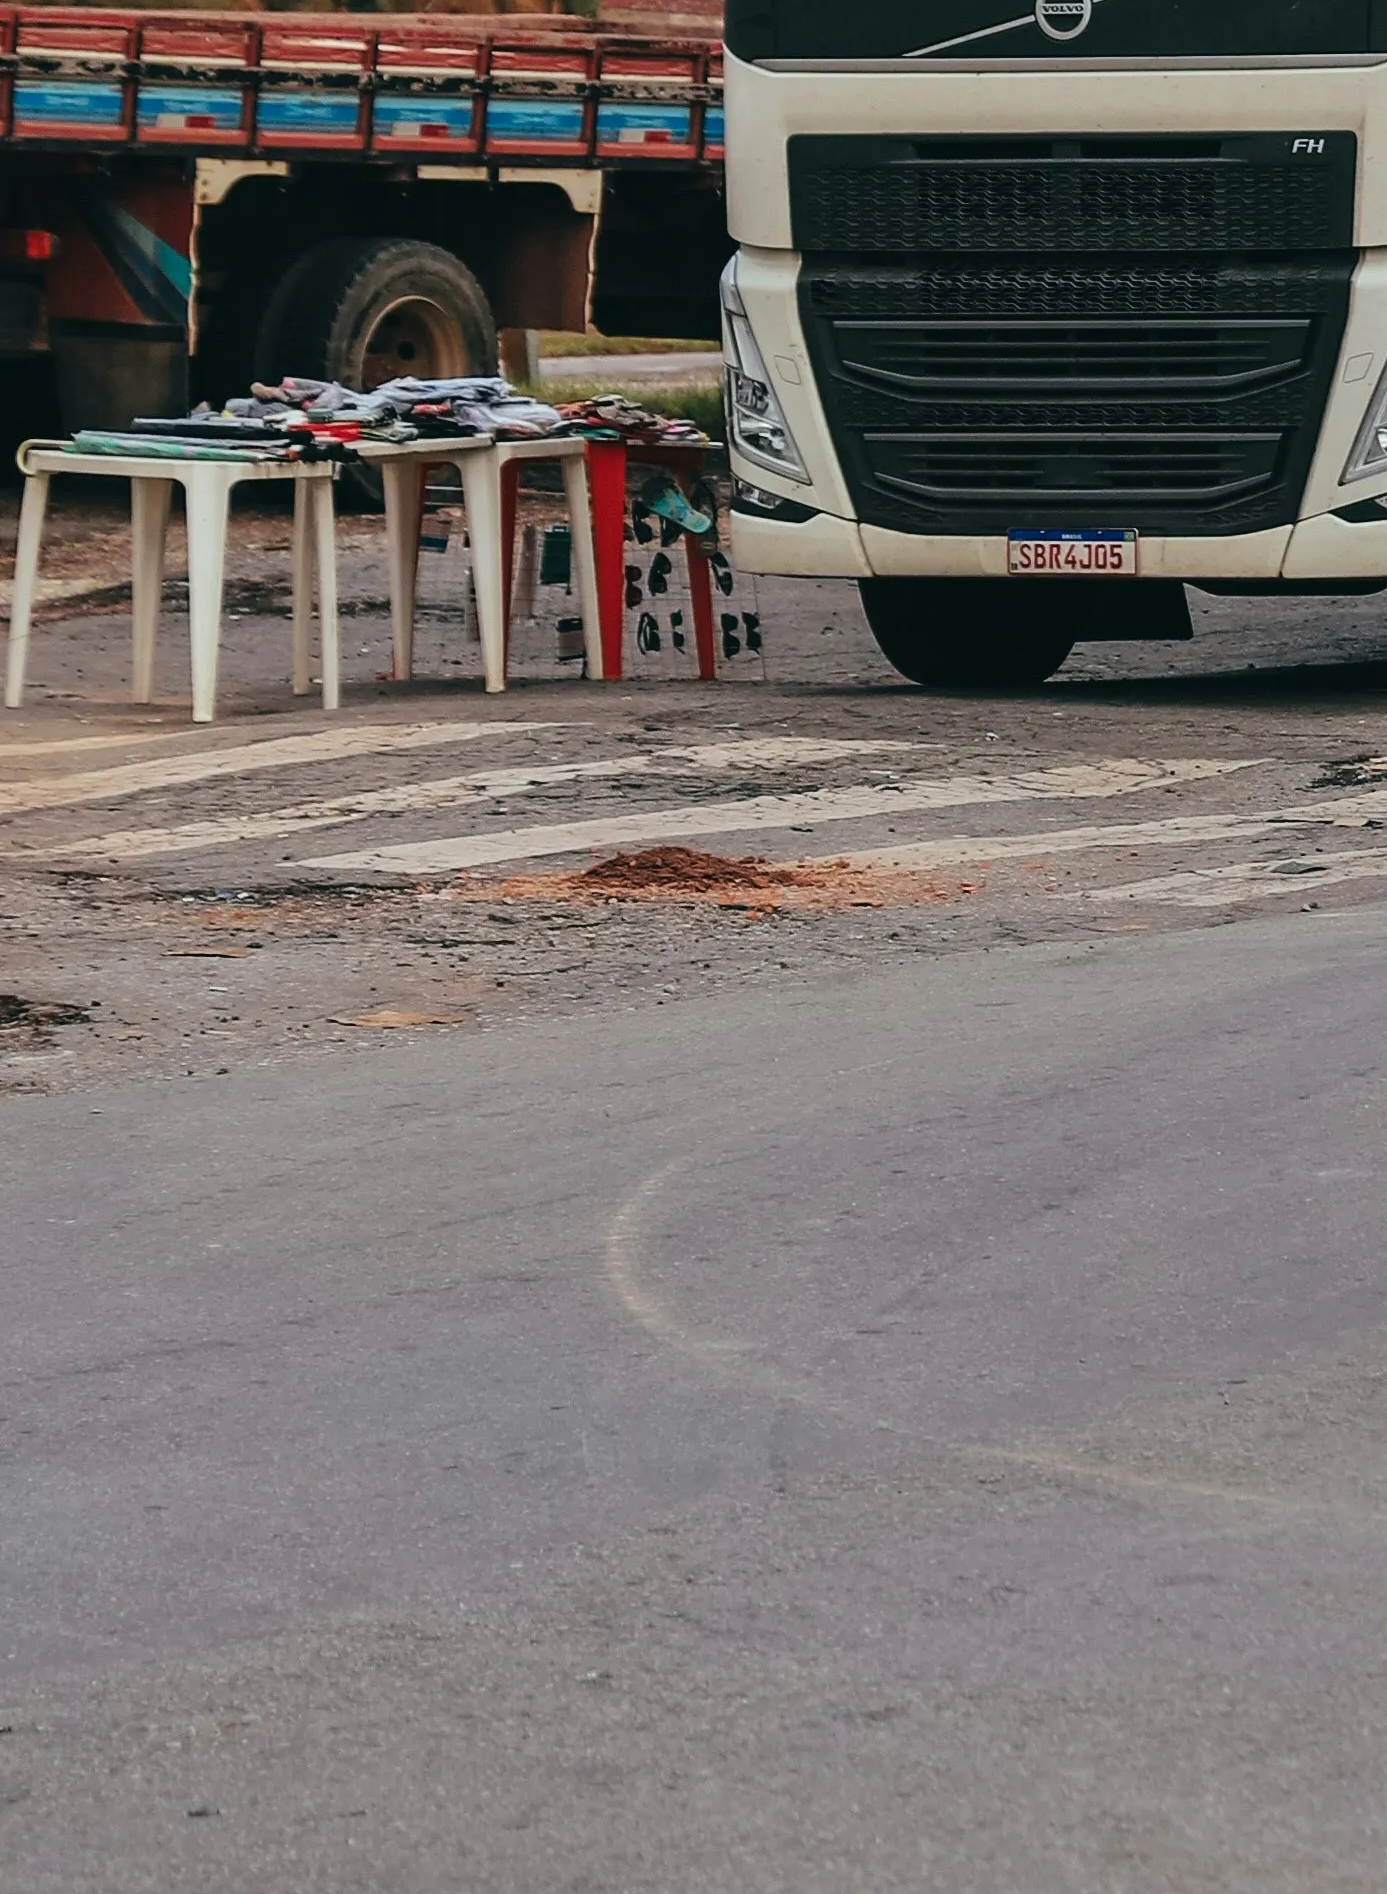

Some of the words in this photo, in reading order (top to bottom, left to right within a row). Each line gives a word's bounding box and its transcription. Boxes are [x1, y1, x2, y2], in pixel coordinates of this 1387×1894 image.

[1041, 5, 1085, 13] VOLVO
[1291, 138, 1325, 154] FH
[1019, 543, 1123, 570] SBR4J05
